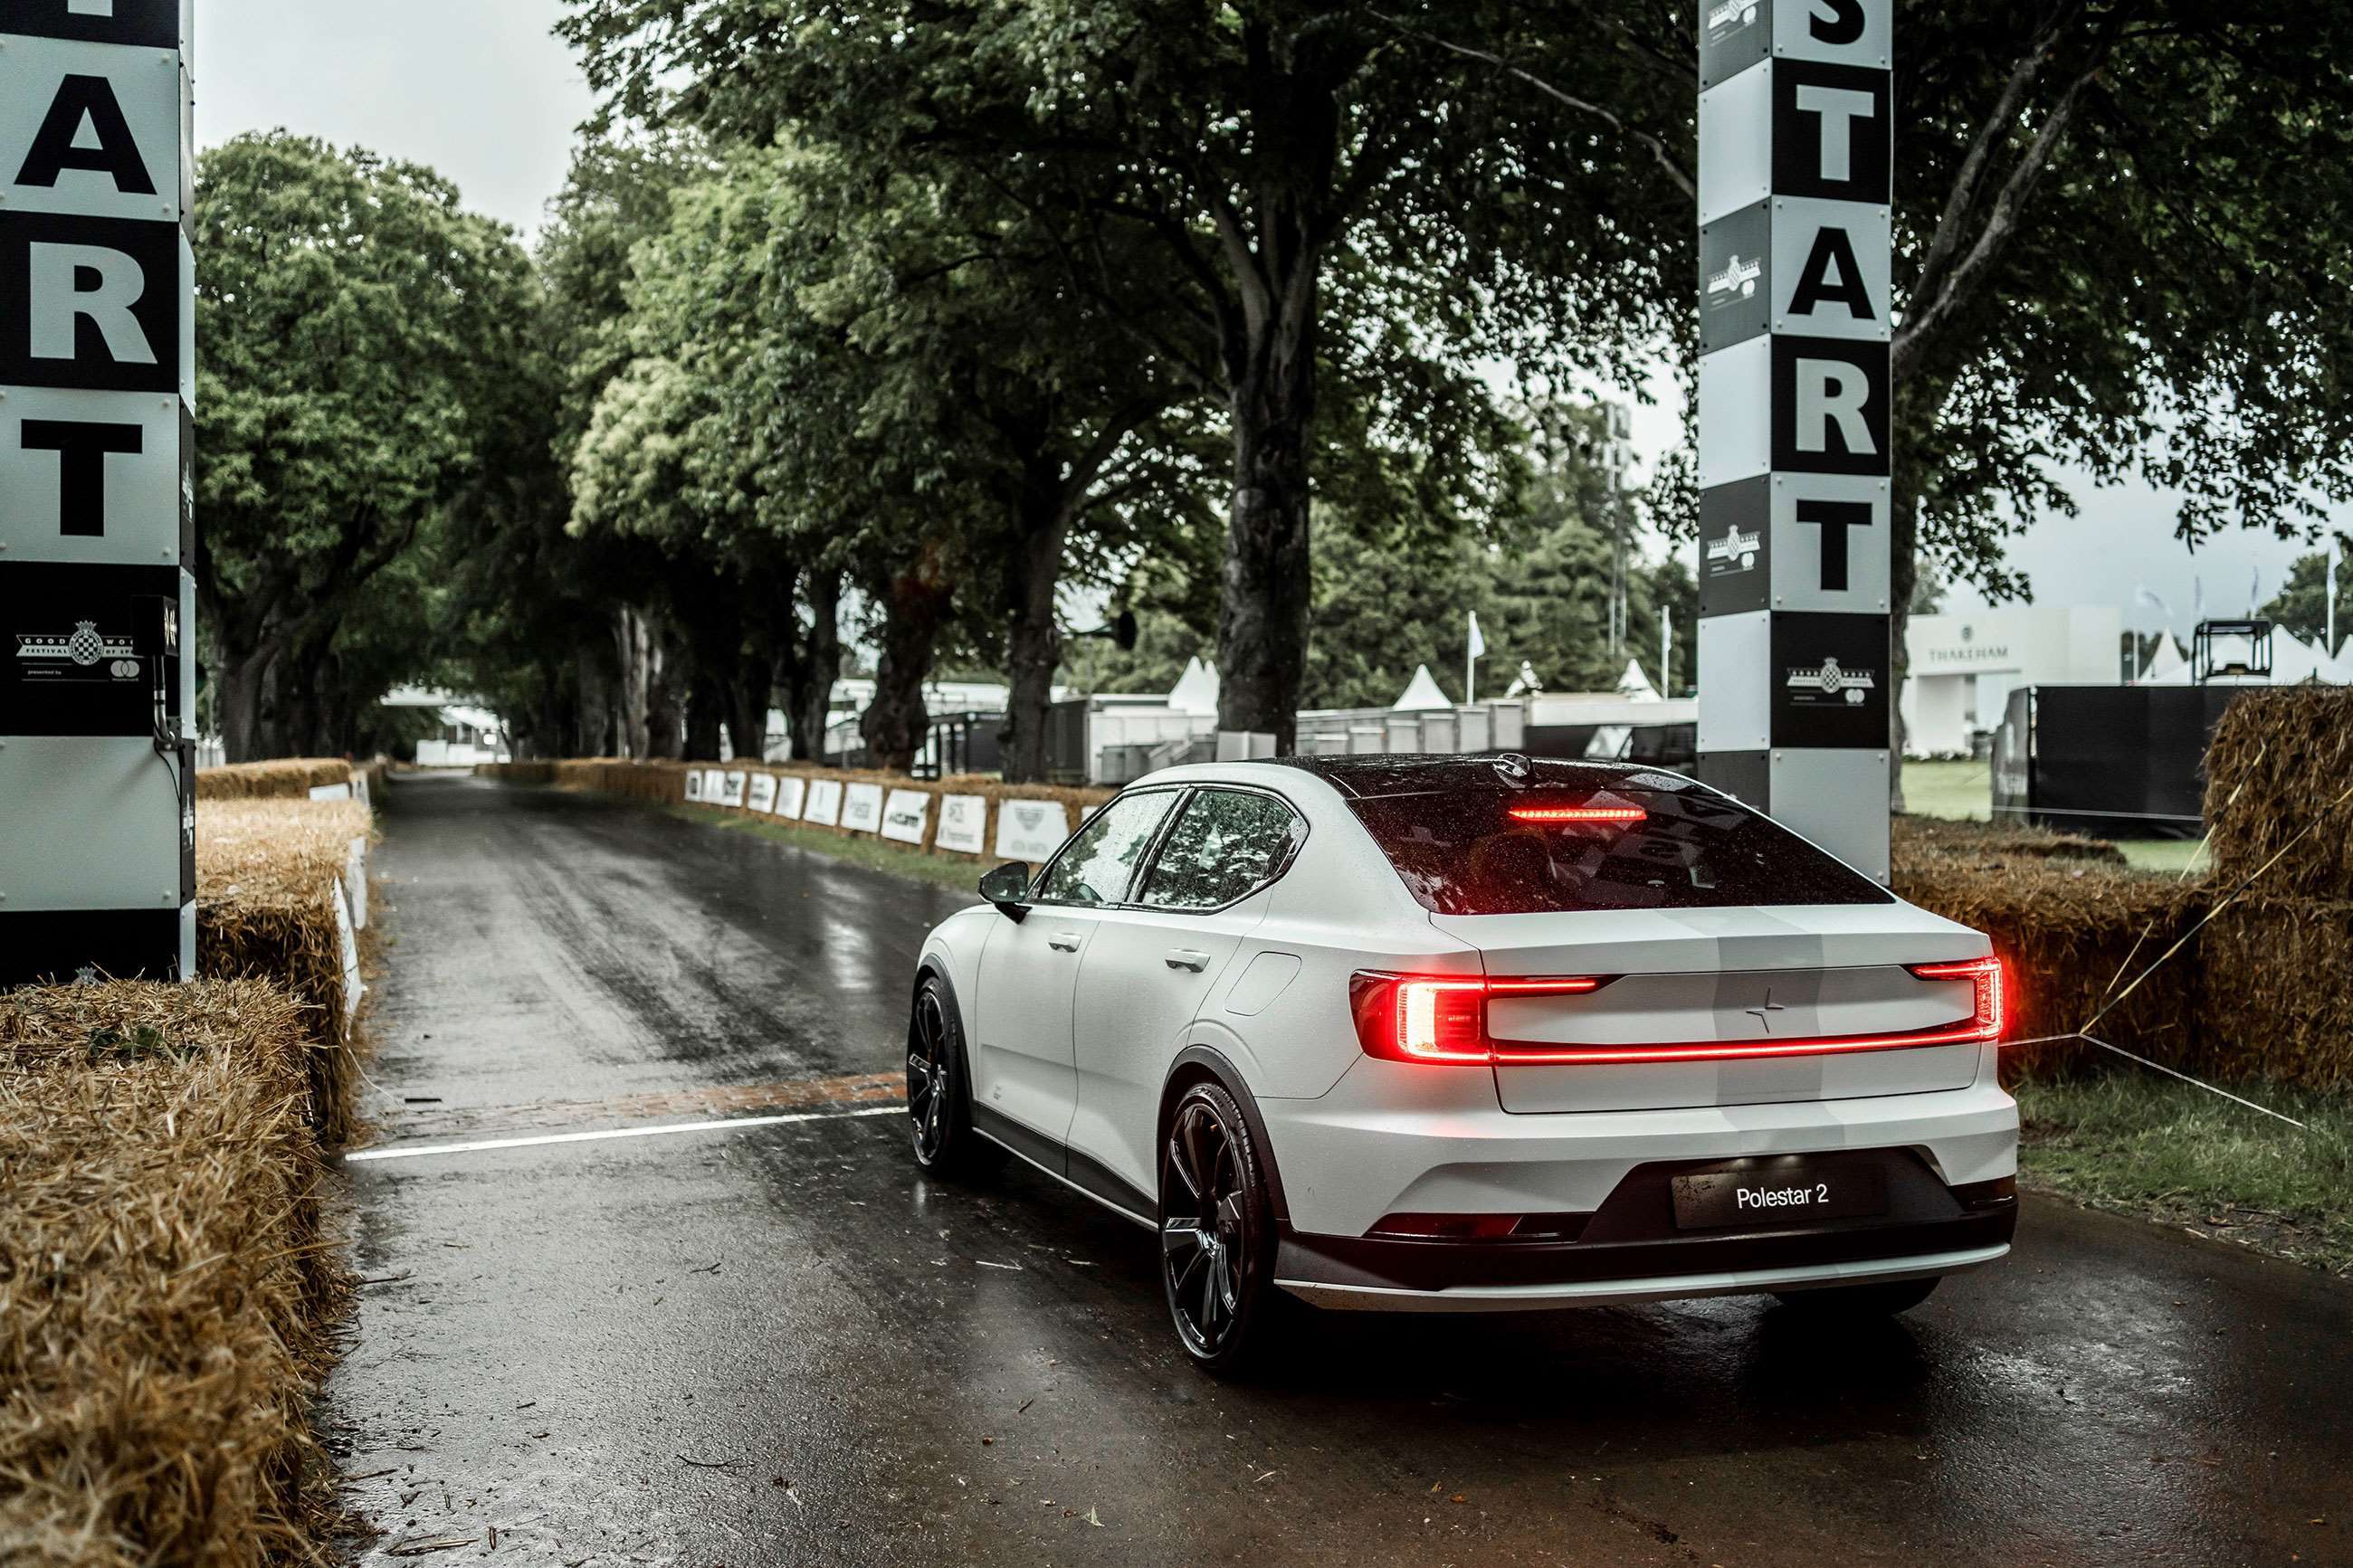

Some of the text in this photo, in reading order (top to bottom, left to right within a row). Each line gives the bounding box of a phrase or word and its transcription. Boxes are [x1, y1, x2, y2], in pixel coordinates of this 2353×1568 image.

[14, 0, 157, 537] ART
[1736, 1183, 1829, 1209] Polestar 2
